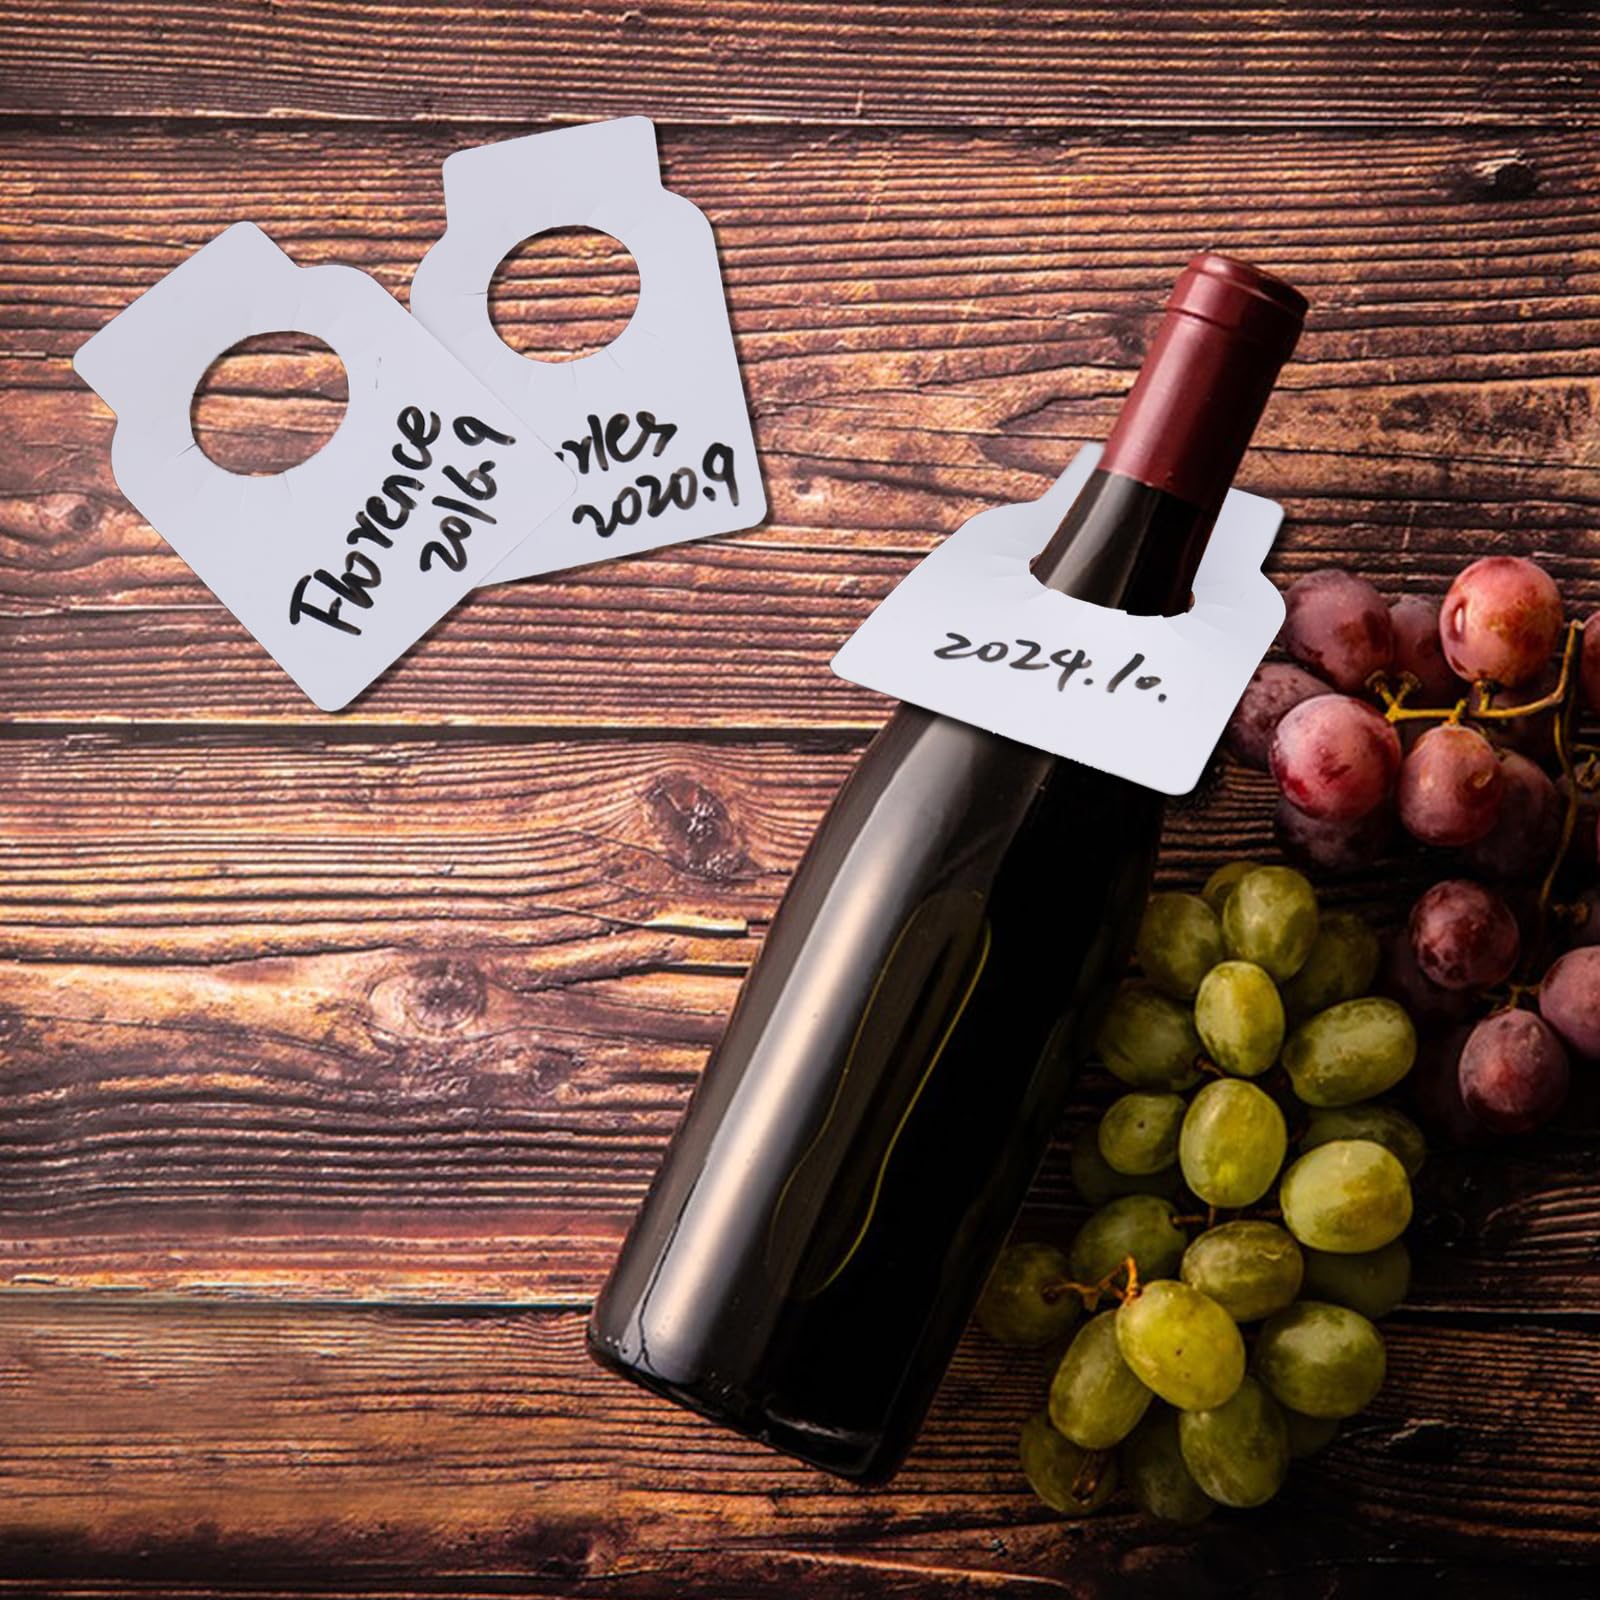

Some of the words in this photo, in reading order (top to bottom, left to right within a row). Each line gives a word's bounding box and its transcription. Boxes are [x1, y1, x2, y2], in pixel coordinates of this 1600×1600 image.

[554, 410, 679, 476] rles
[571, 441, 741, 539] 2020.9
[289, 405, 442, 637] Florence
